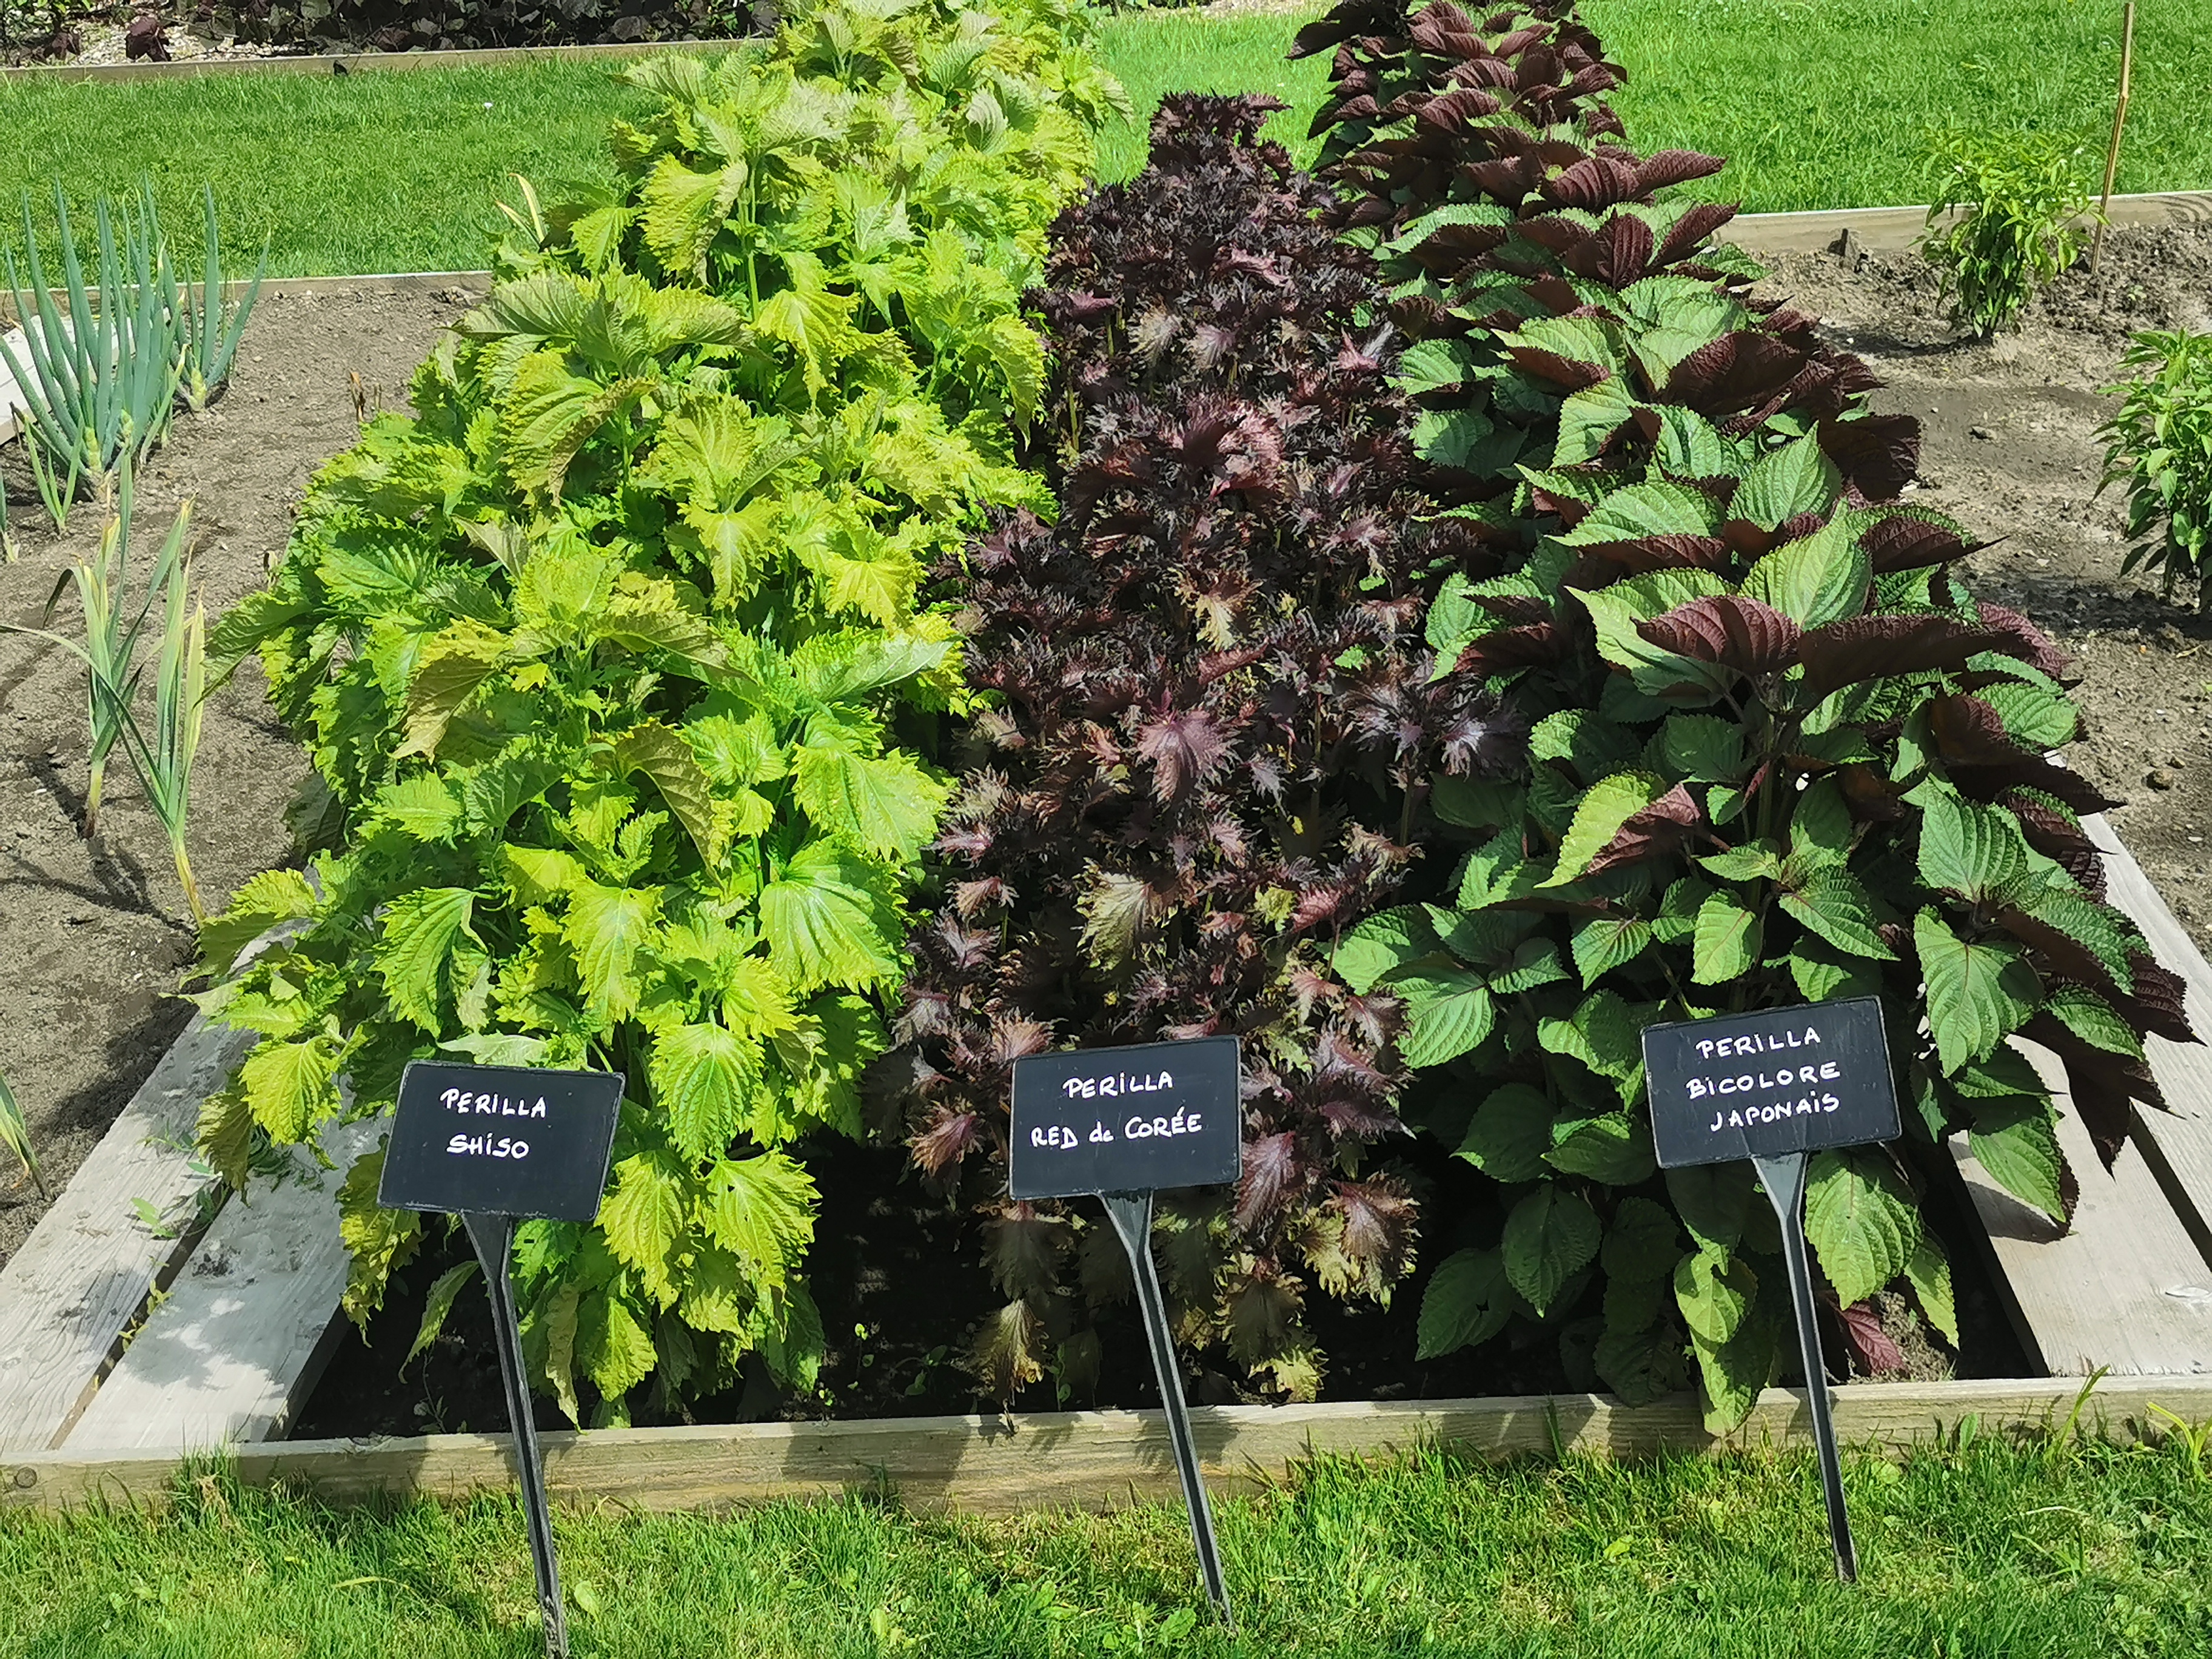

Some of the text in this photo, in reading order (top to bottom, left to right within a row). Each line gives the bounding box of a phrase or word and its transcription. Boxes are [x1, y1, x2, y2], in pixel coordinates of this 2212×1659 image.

[440, 1088, 546, 1118] PERILLA
[1031, 1125, 1078, 1150] RED
[1124, 1106, 1202, 1139] CORÉE
